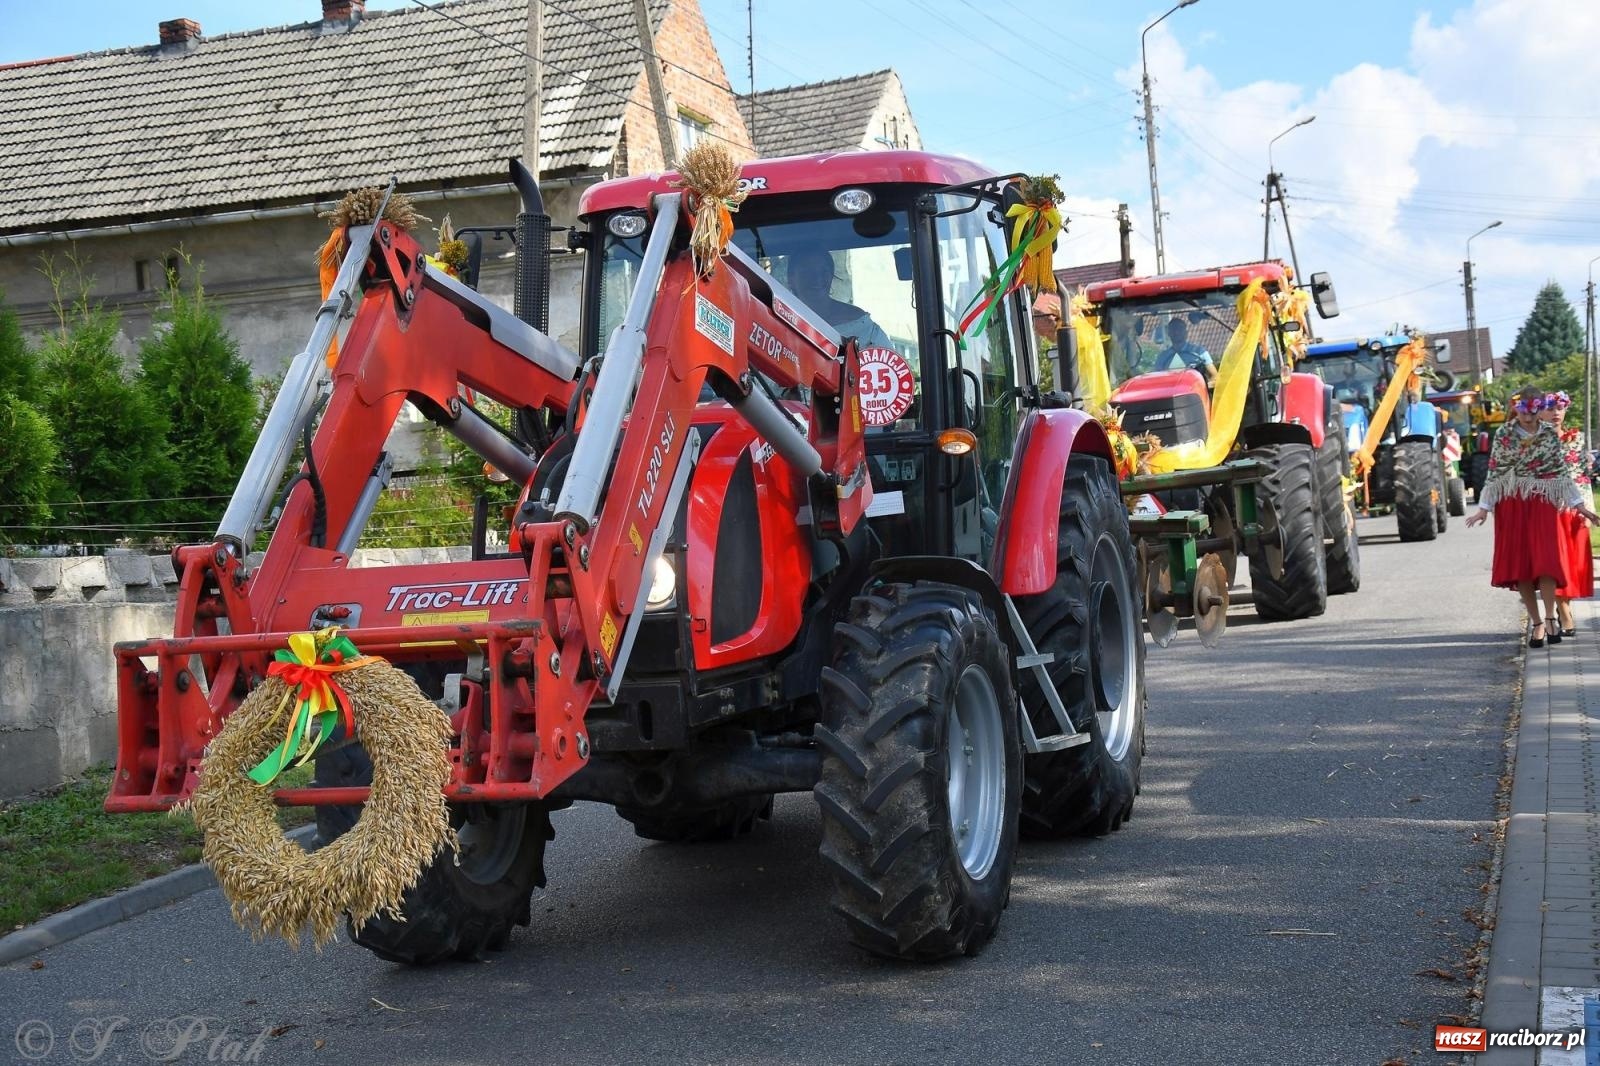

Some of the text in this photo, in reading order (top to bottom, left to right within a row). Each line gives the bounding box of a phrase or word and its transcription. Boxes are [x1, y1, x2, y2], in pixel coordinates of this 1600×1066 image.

[749, 322, 782, 362] ZETOR
[859, 368, 892, 398] 3,5
[866, 399, 887, 409] ROKU
[638, 487, 653, 519] TL
[646, 445, 662, 494] 220
[385, 582, 519, 611] Trac-Lift
